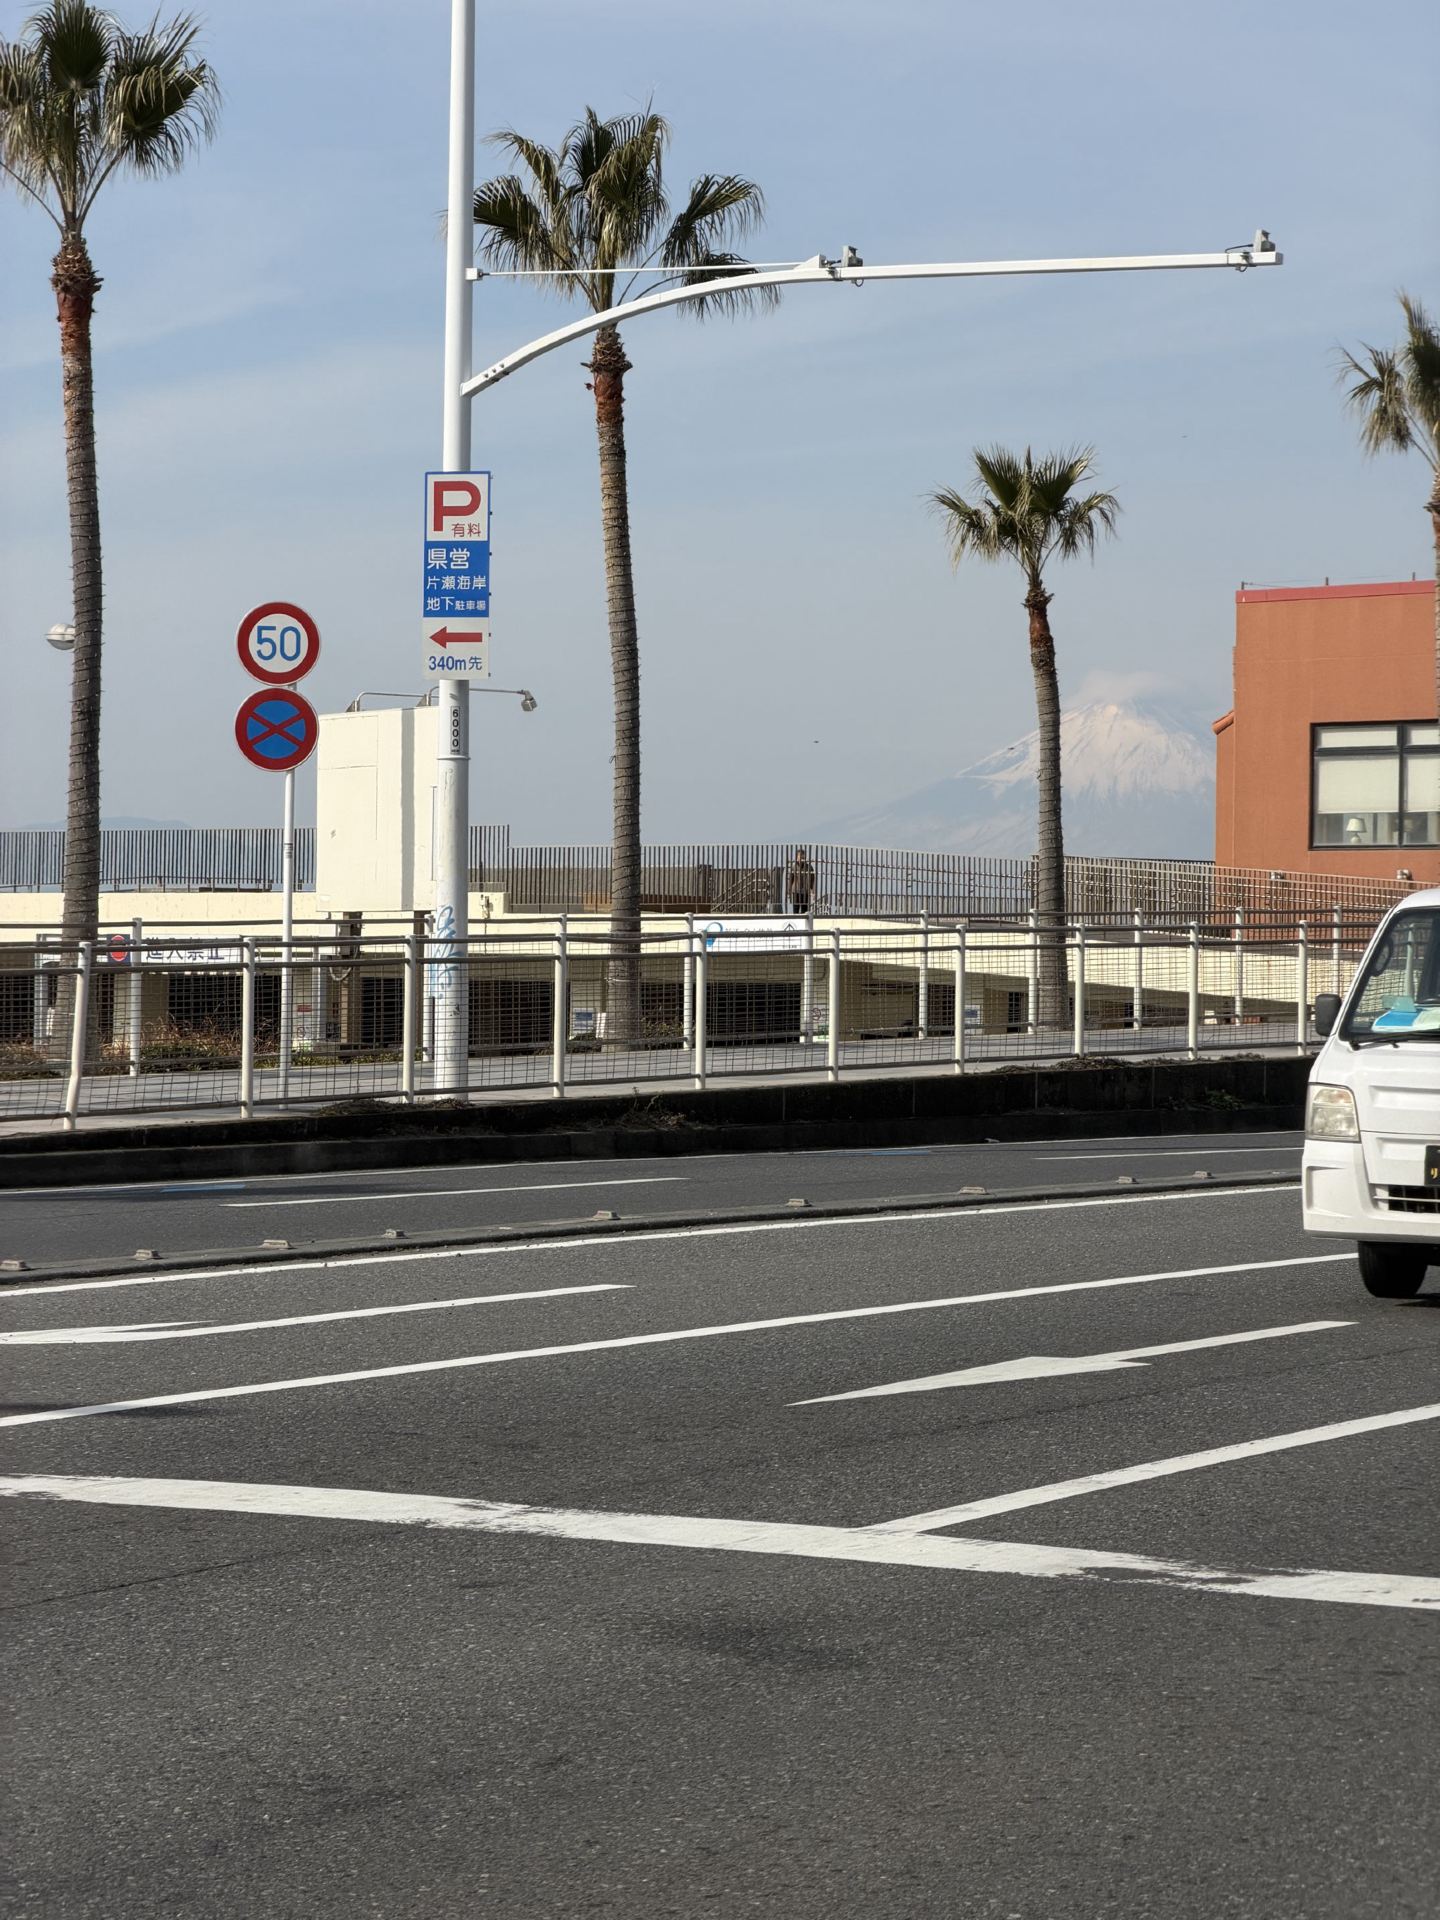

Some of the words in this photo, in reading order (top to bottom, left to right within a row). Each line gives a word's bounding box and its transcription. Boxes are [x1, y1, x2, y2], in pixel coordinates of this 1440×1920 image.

[434, 481, 481, 531] P
[451, 523, 481, 537] 有料
[427, 548, 470, 569] 県営
[427, 575, 486, 590] 片瀬海岸
[257, 625, 301, 661] 50
[429, 656, 482, 670] 340m先
